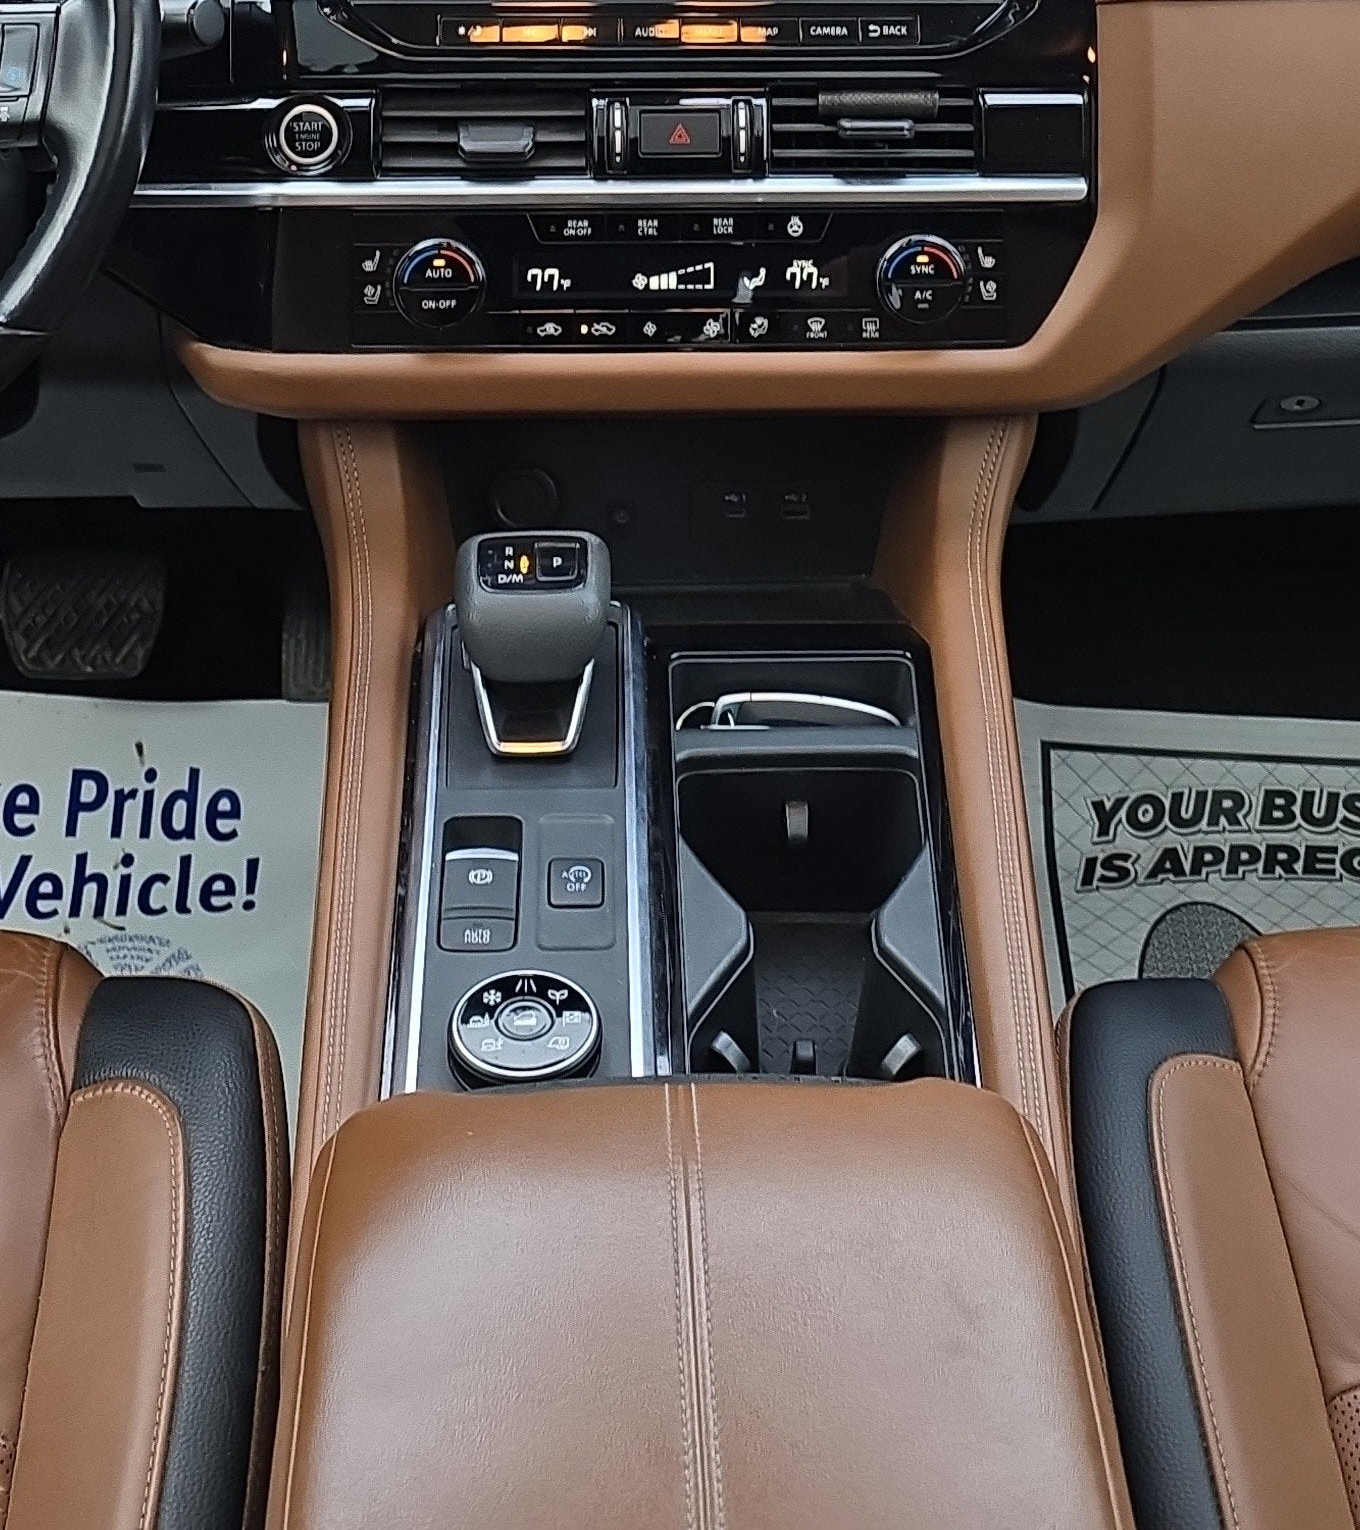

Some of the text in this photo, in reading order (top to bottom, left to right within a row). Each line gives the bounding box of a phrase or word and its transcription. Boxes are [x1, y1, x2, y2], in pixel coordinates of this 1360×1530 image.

[634, 26, 668, 38] AUDI
[757, 26, 779, 37] MAP
[809, 25, 848, 37] CAMERA
[883, 25, 908, 37] BACK
[292, 121, 323, 132] START
[295, 132, 320, 140] ENGINE
[295, 141, 321, 151] STOP
[567, 219, 589, 228] REAR
[637, 219, 659, 228] REAR
[713, 217, 734, 226] REAR
[637, 227, 659, 236] CTRL
[713, 225, 734, 235] LOCK
[425, 267, 453, 279] AUTO
[909, 264, 935, 275] SYNC
[914, 290, 933, 301] A/C
[806, 330, 828, 339] FRONT
[505, 546, 514, 557] R
[504, 559, 515, 570] N
[552, 556, 563, 568] P
[497, 573, 524, 584] D/M
[64, 766, 242, 842] Pride
[1088, 787, 1246, 840] YOUR
[1078, 851, 1138, 888] IS
[566, 883, 587, 893] OFF
